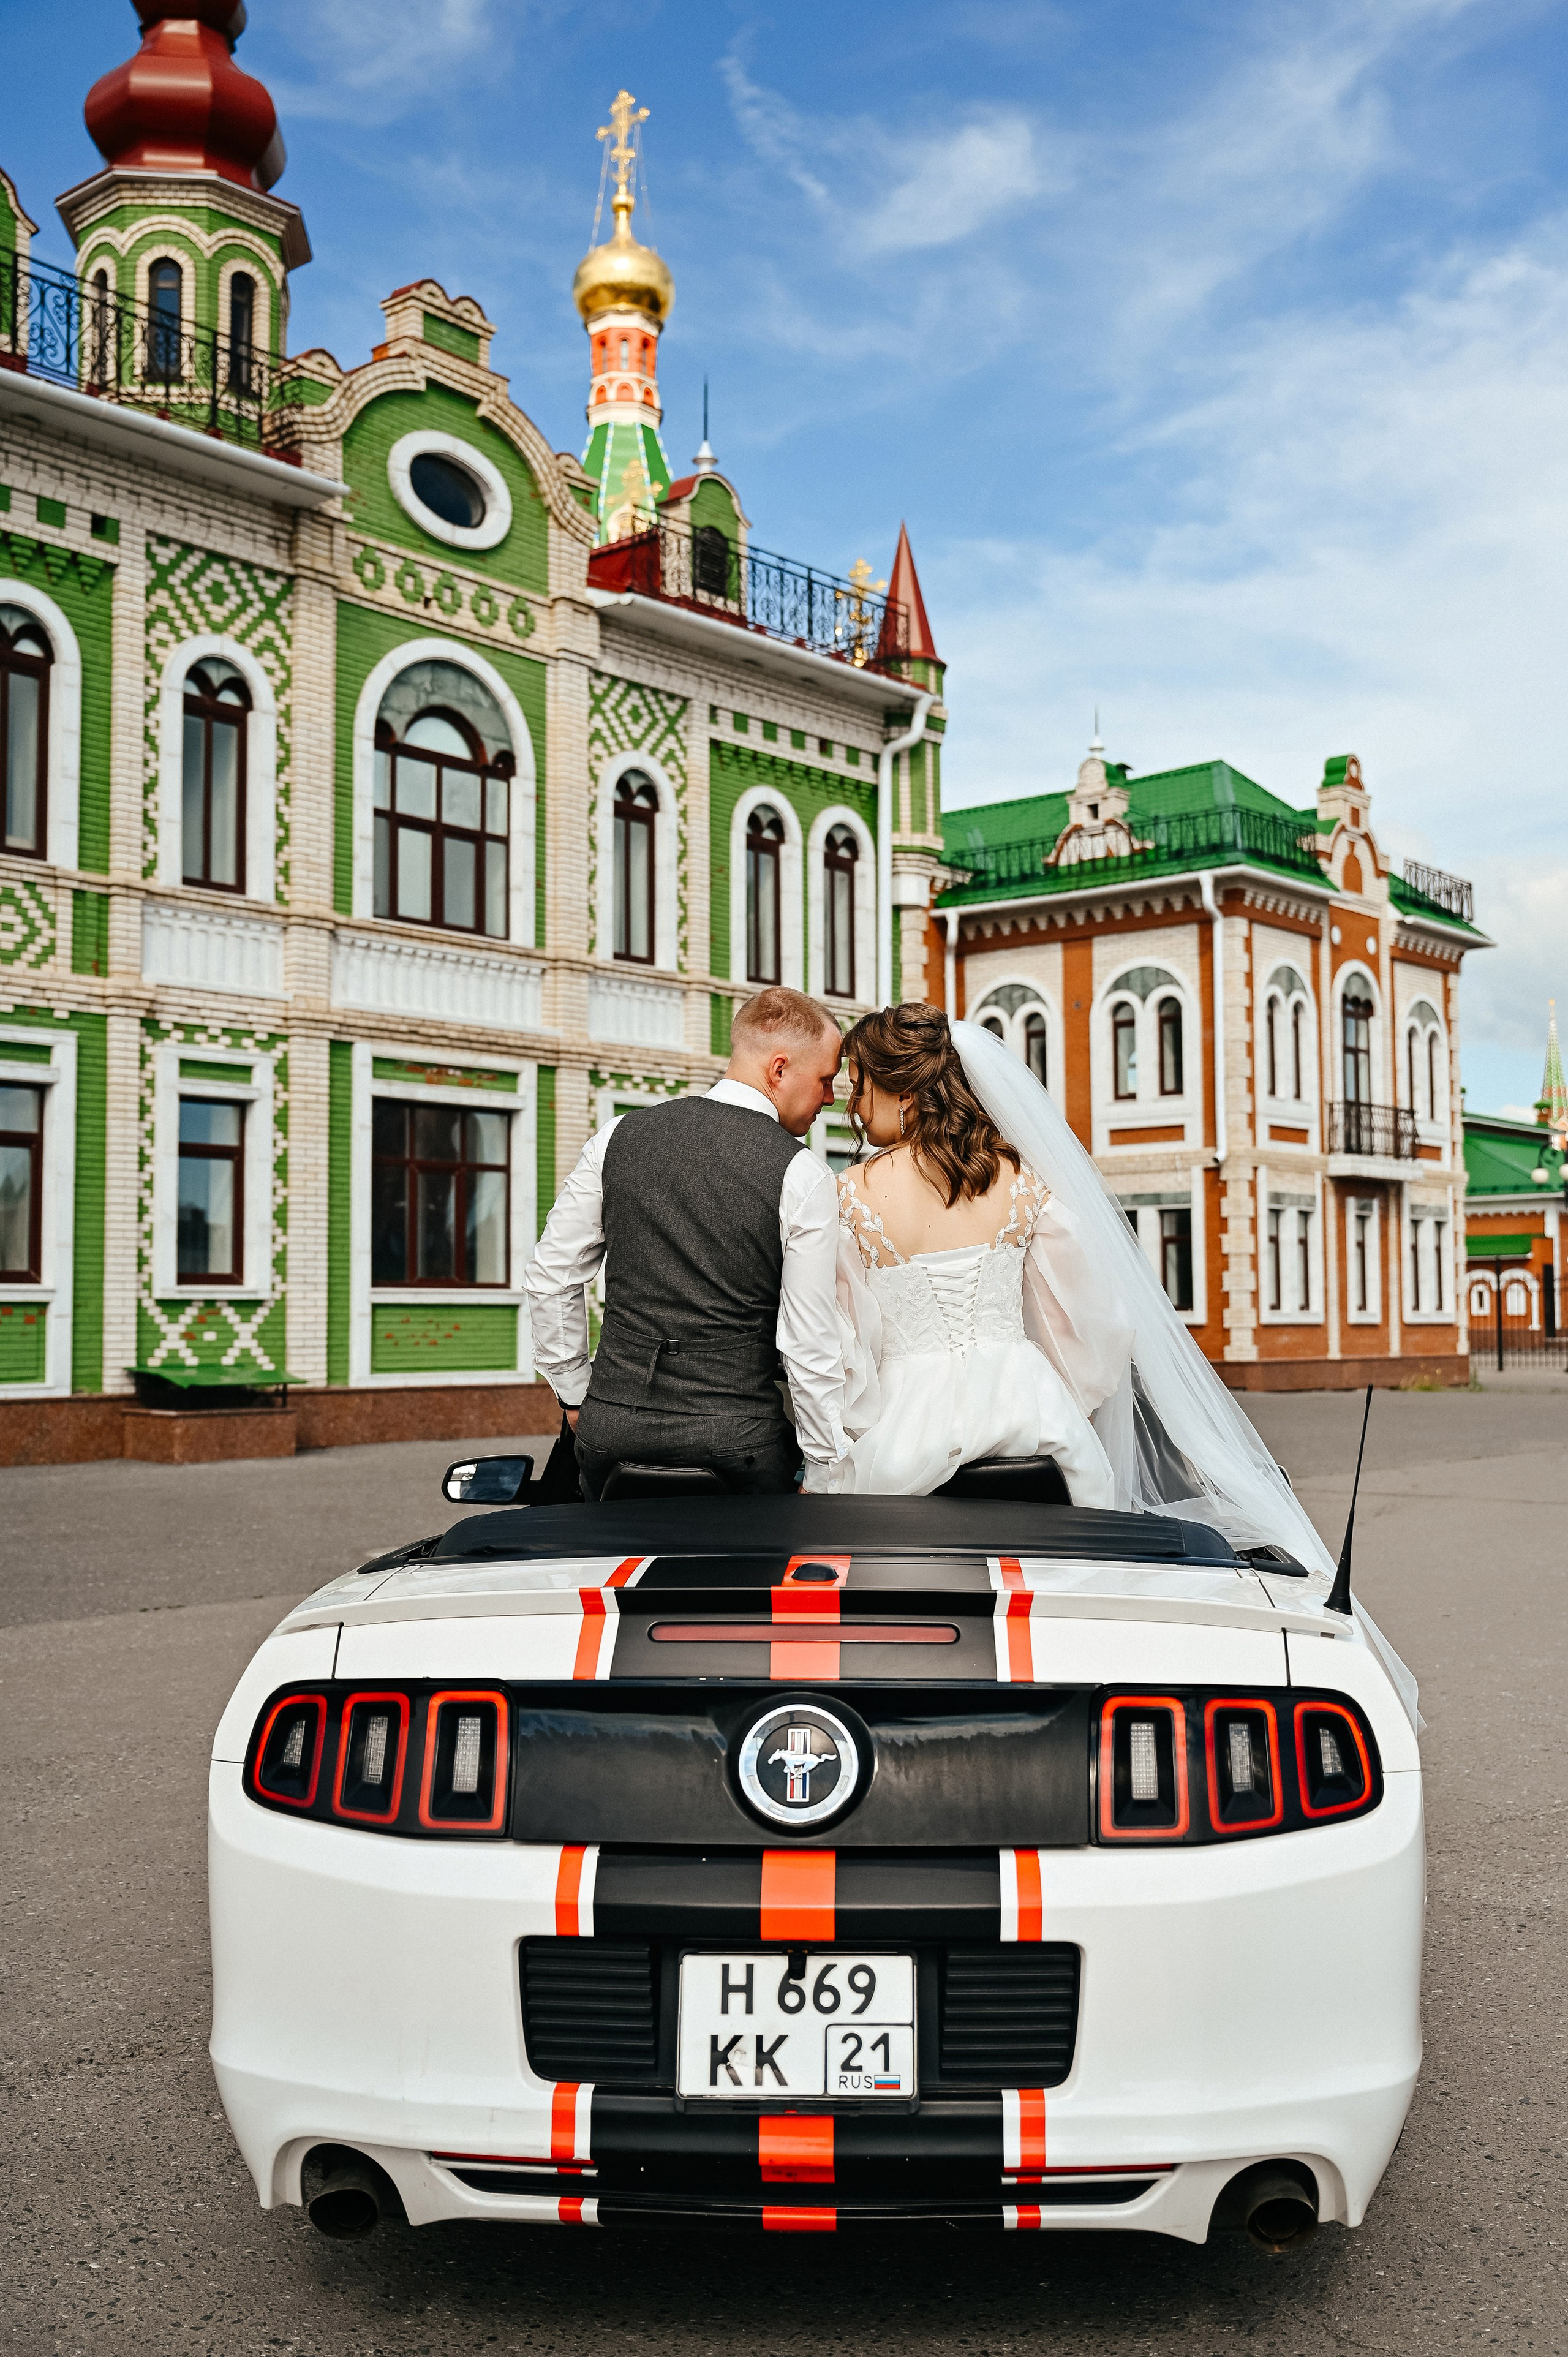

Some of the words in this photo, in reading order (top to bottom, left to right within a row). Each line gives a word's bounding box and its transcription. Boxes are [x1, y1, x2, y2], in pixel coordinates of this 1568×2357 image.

[777, 1963, 876, 2014] 669
[840, 2032, 890, 2072] 21
[839, 2075, 873, 2089] RUS
